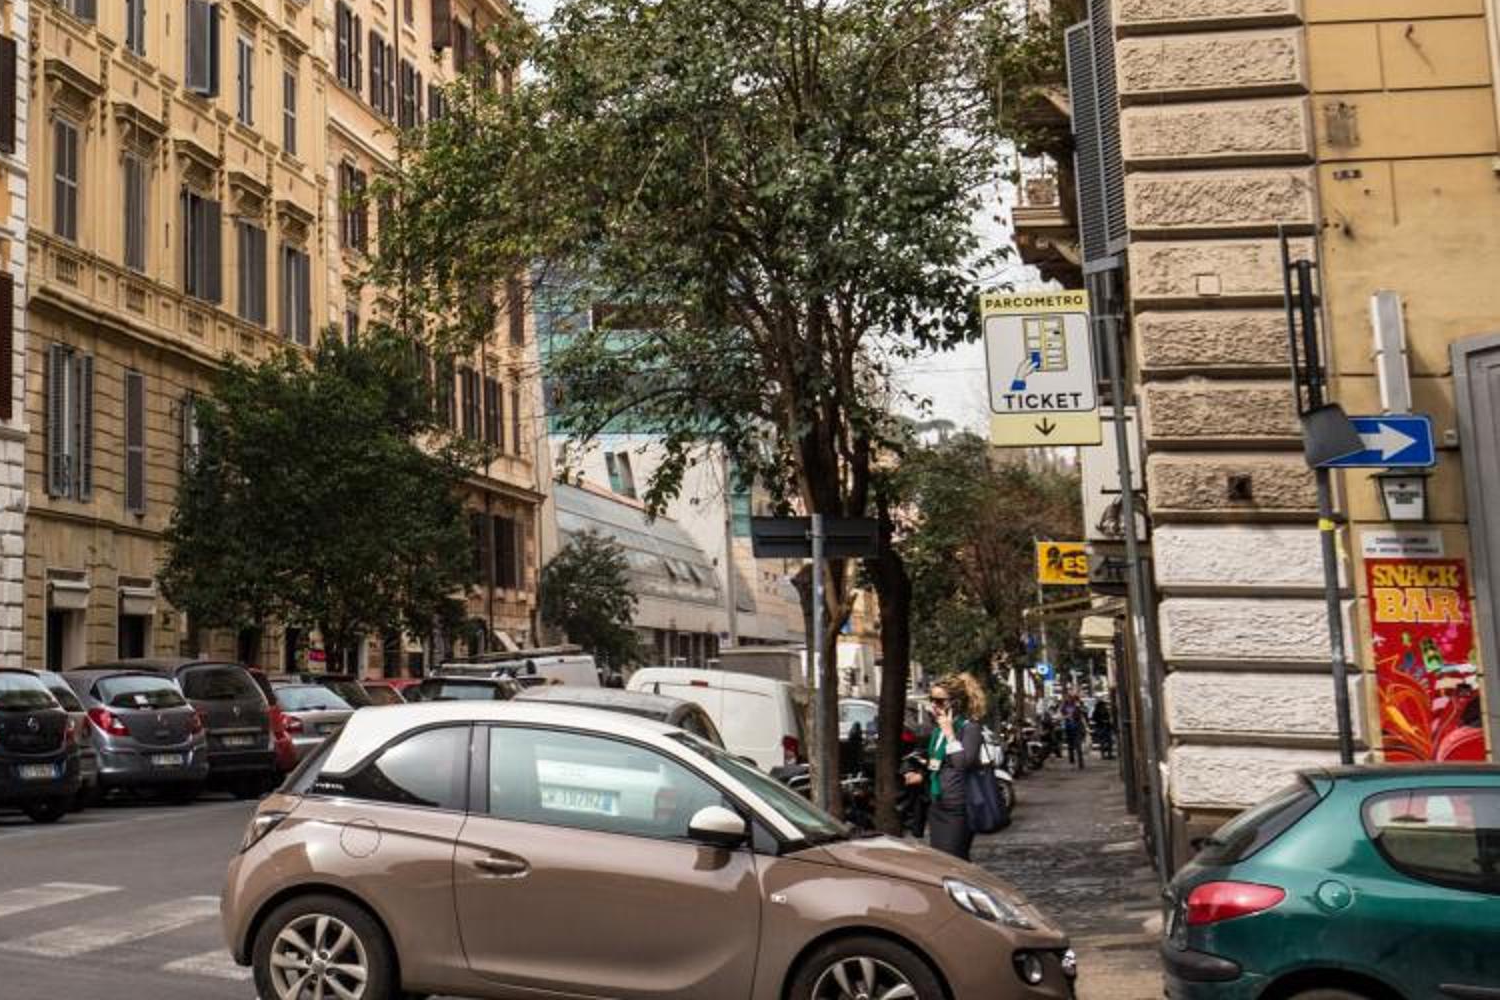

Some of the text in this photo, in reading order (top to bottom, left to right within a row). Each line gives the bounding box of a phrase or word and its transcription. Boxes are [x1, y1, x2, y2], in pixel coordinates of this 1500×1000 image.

[985, 294, 1084, 309] PARCOMETRO
[1002, 392, 1082, 410] TICKET
[1372, 564, 1459, 587] SNACK
[1372, 587, 1466, 624] BAR
